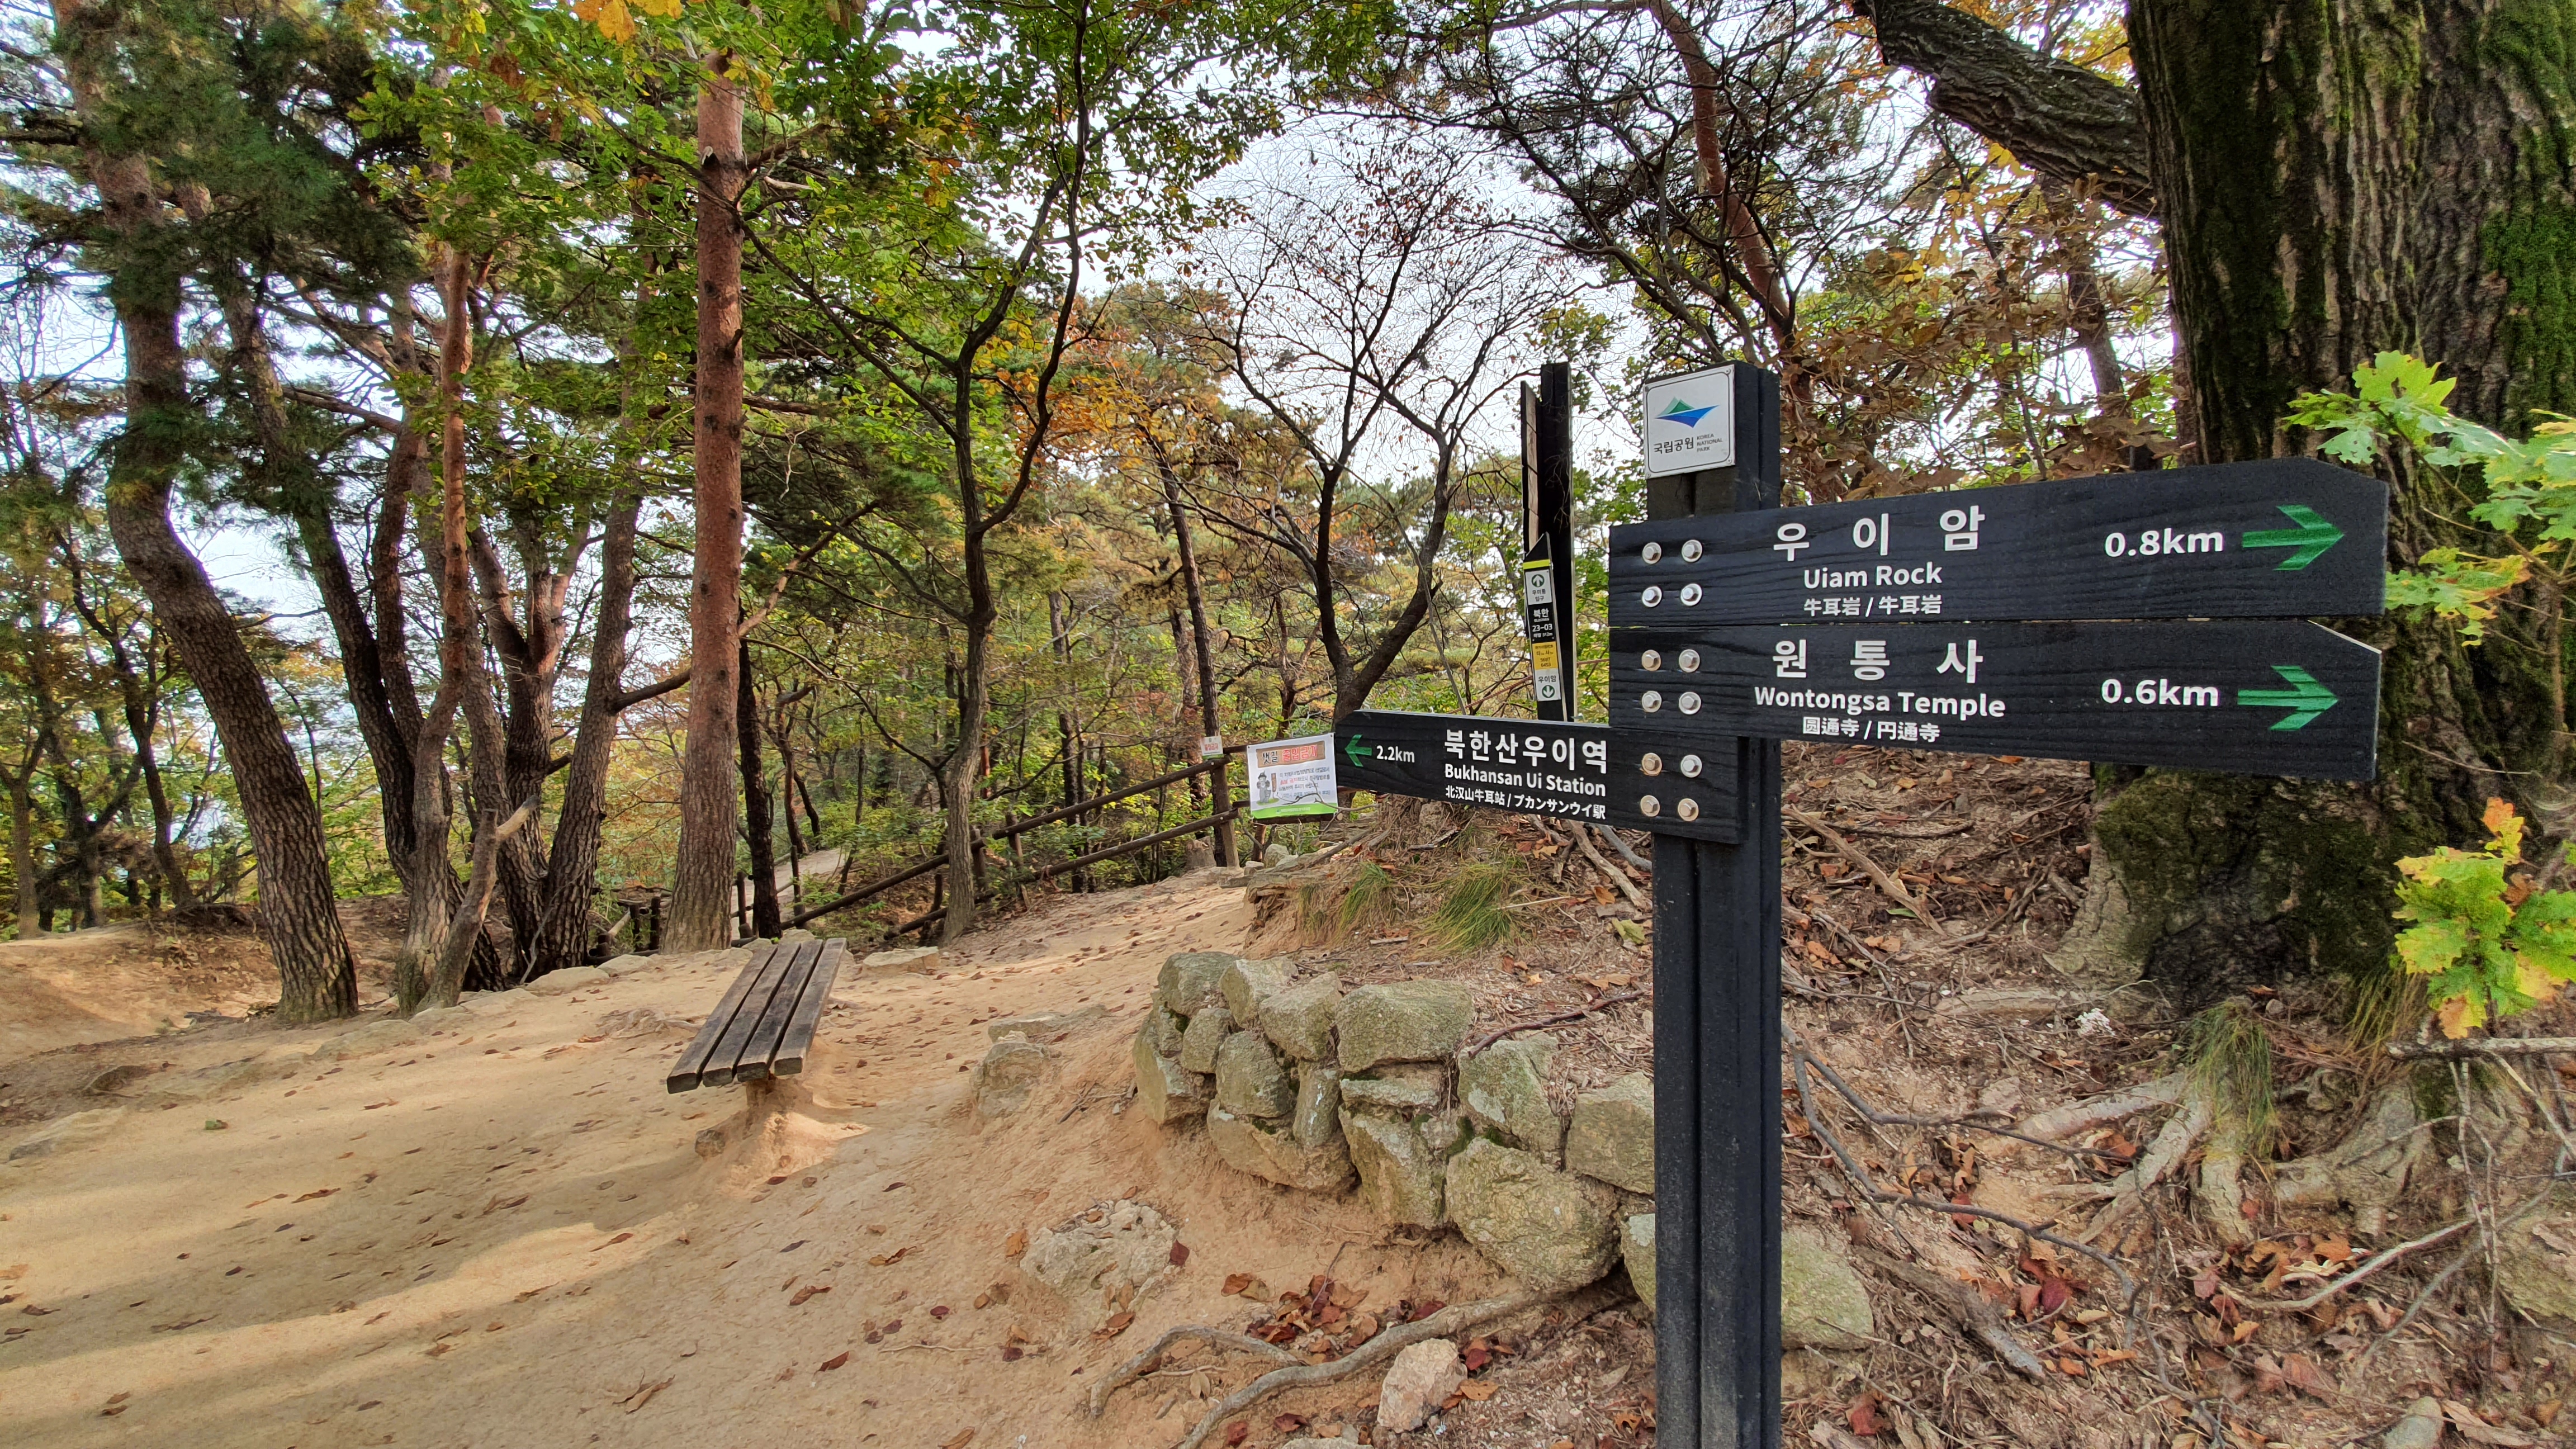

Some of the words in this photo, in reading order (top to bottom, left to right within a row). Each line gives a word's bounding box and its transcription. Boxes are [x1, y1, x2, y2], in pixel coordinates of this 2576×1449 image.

[1654, 437, 1694, 454] 국립공원
[1697, 438, 1723, 447] NATIONAL
[2104, 527, 2224, 558] 0.8km
[1803, 567, 1868, 589] Uiam
[1876, 561, 1943, 586] Rock
[1533, 608, 1549, 618] 북한
[1803, 596, 1861, 617] 牛耳岩
[1878, 594, 1942, 615] 牛耳岩
[1532, 623, 1553, 632] 23-03
[1754, 686, 1890, 716] Wontongsa
[1897, 692, 2006, 721] Temple
[2101, 678, 2220, 707] 0.6km
[1877, 721, 1940, 743] 円通寺
[1262, 751, 1278, 765] 샛길
[1282, 744, 1318, 762] 출입금지
[1376, 745, 1415, 764] 2.2km
[1444, 729, 1607, 774] 북한산우이역
[1445, 764, 1522, 788] Bukhansan
[1526, 773, 1542, 790] Ui
[1546, 774, 1606, 797] Station
[1445, 785, 1505, 805] 北汉山牛耳站
[1514, 793, 1606, 820] プカンサンウイ駅
